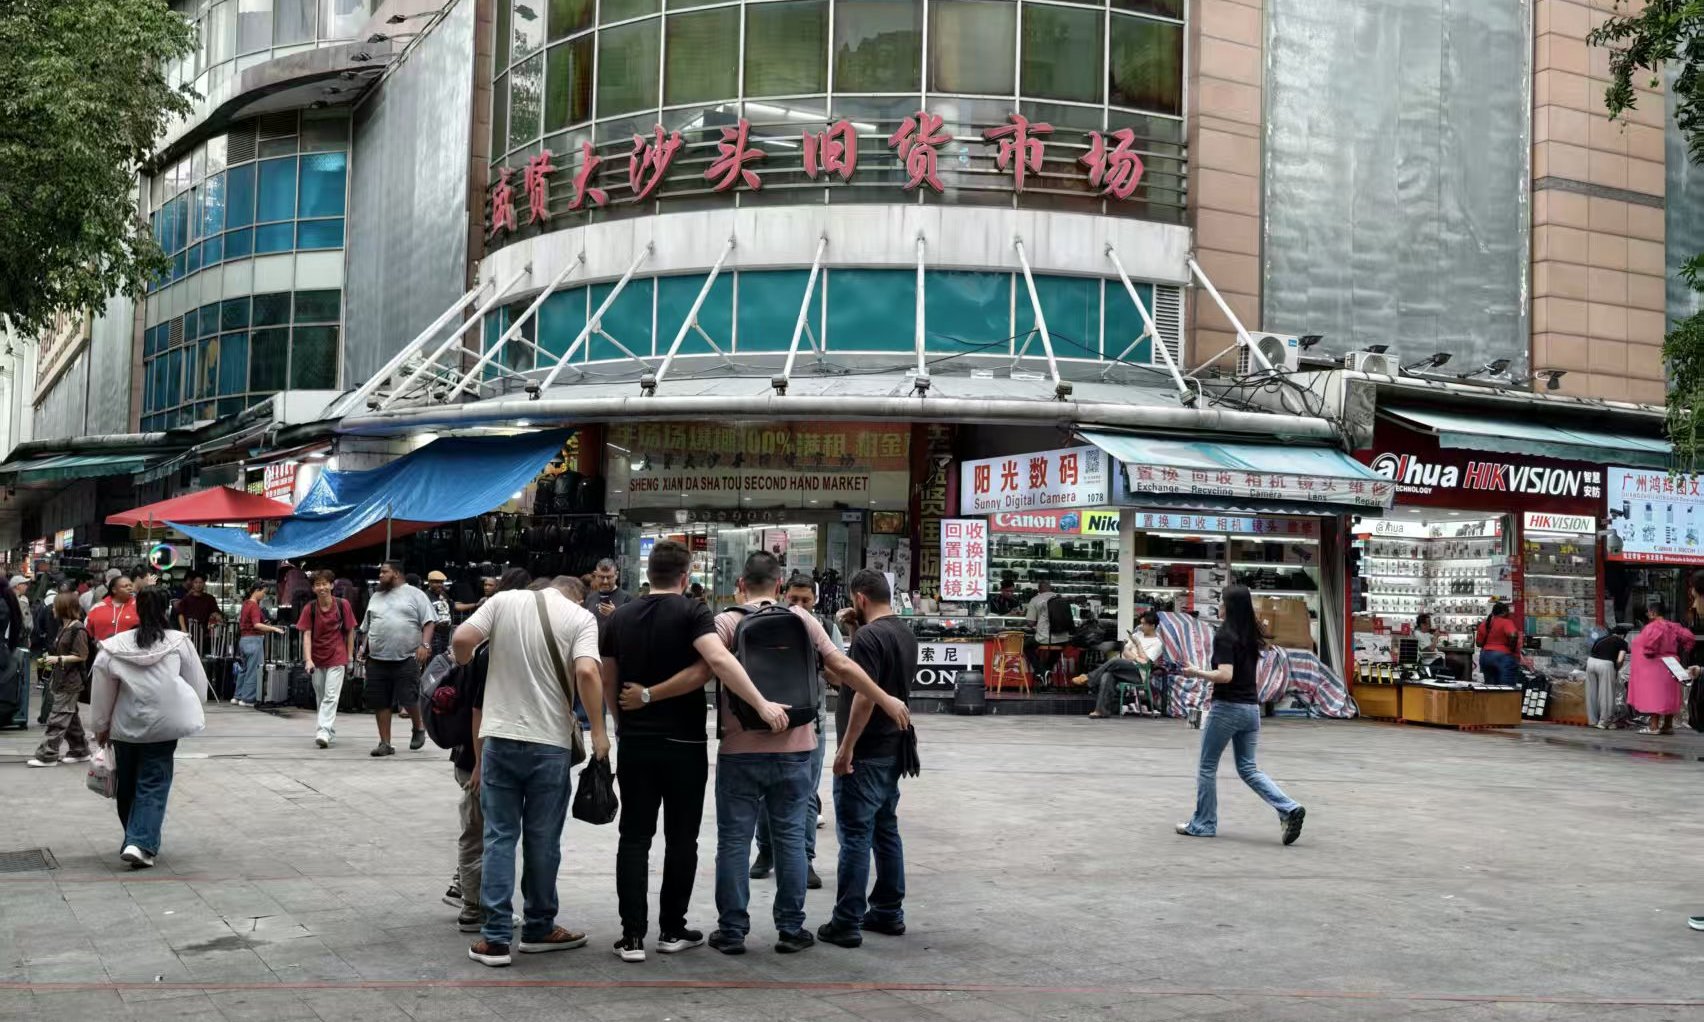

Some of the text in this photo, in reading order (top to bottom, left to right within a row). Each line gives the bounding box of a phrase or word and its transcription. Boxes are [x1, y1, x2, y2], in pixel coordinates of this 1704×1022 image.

[487, 111, 1145, 236] 盛贤大沙头旧货市场
[974, 453, 1078, 495] 阳光数码
[1137, 466, 1179, 481] 置换
[1191, 470, 1232, 485] 回收
[1245, 472, 1287, 489] 相机
[1298, 477, 1336, 491] 镜头
[1463, 461, 1581, 496] HIKVISION
[630, 476, 868, 492] SHENG XIAN DA SHA TOU SECOND HAND MARKET
[1395, 485, 1432, 494] ECHNOLOGY
[974, 491, 1076, 511] Sunny Digital Camera
[1087, 493, 1104, 502] 1078
[1137, 482, 1381, 506] Exchange Recycling Camera Lens Repair
[995, 511, 1056, 529] Canon
[1144, 514, 1169, 528] 置换
[1181, 515, 1206, 530] 回收
[1217, 517, 1242, 531] 相机
[1529, 515, 1590, 531] HIKVISION
[921, 647, 958, 662] 索尼
[912, 668, 958, 686] ON
